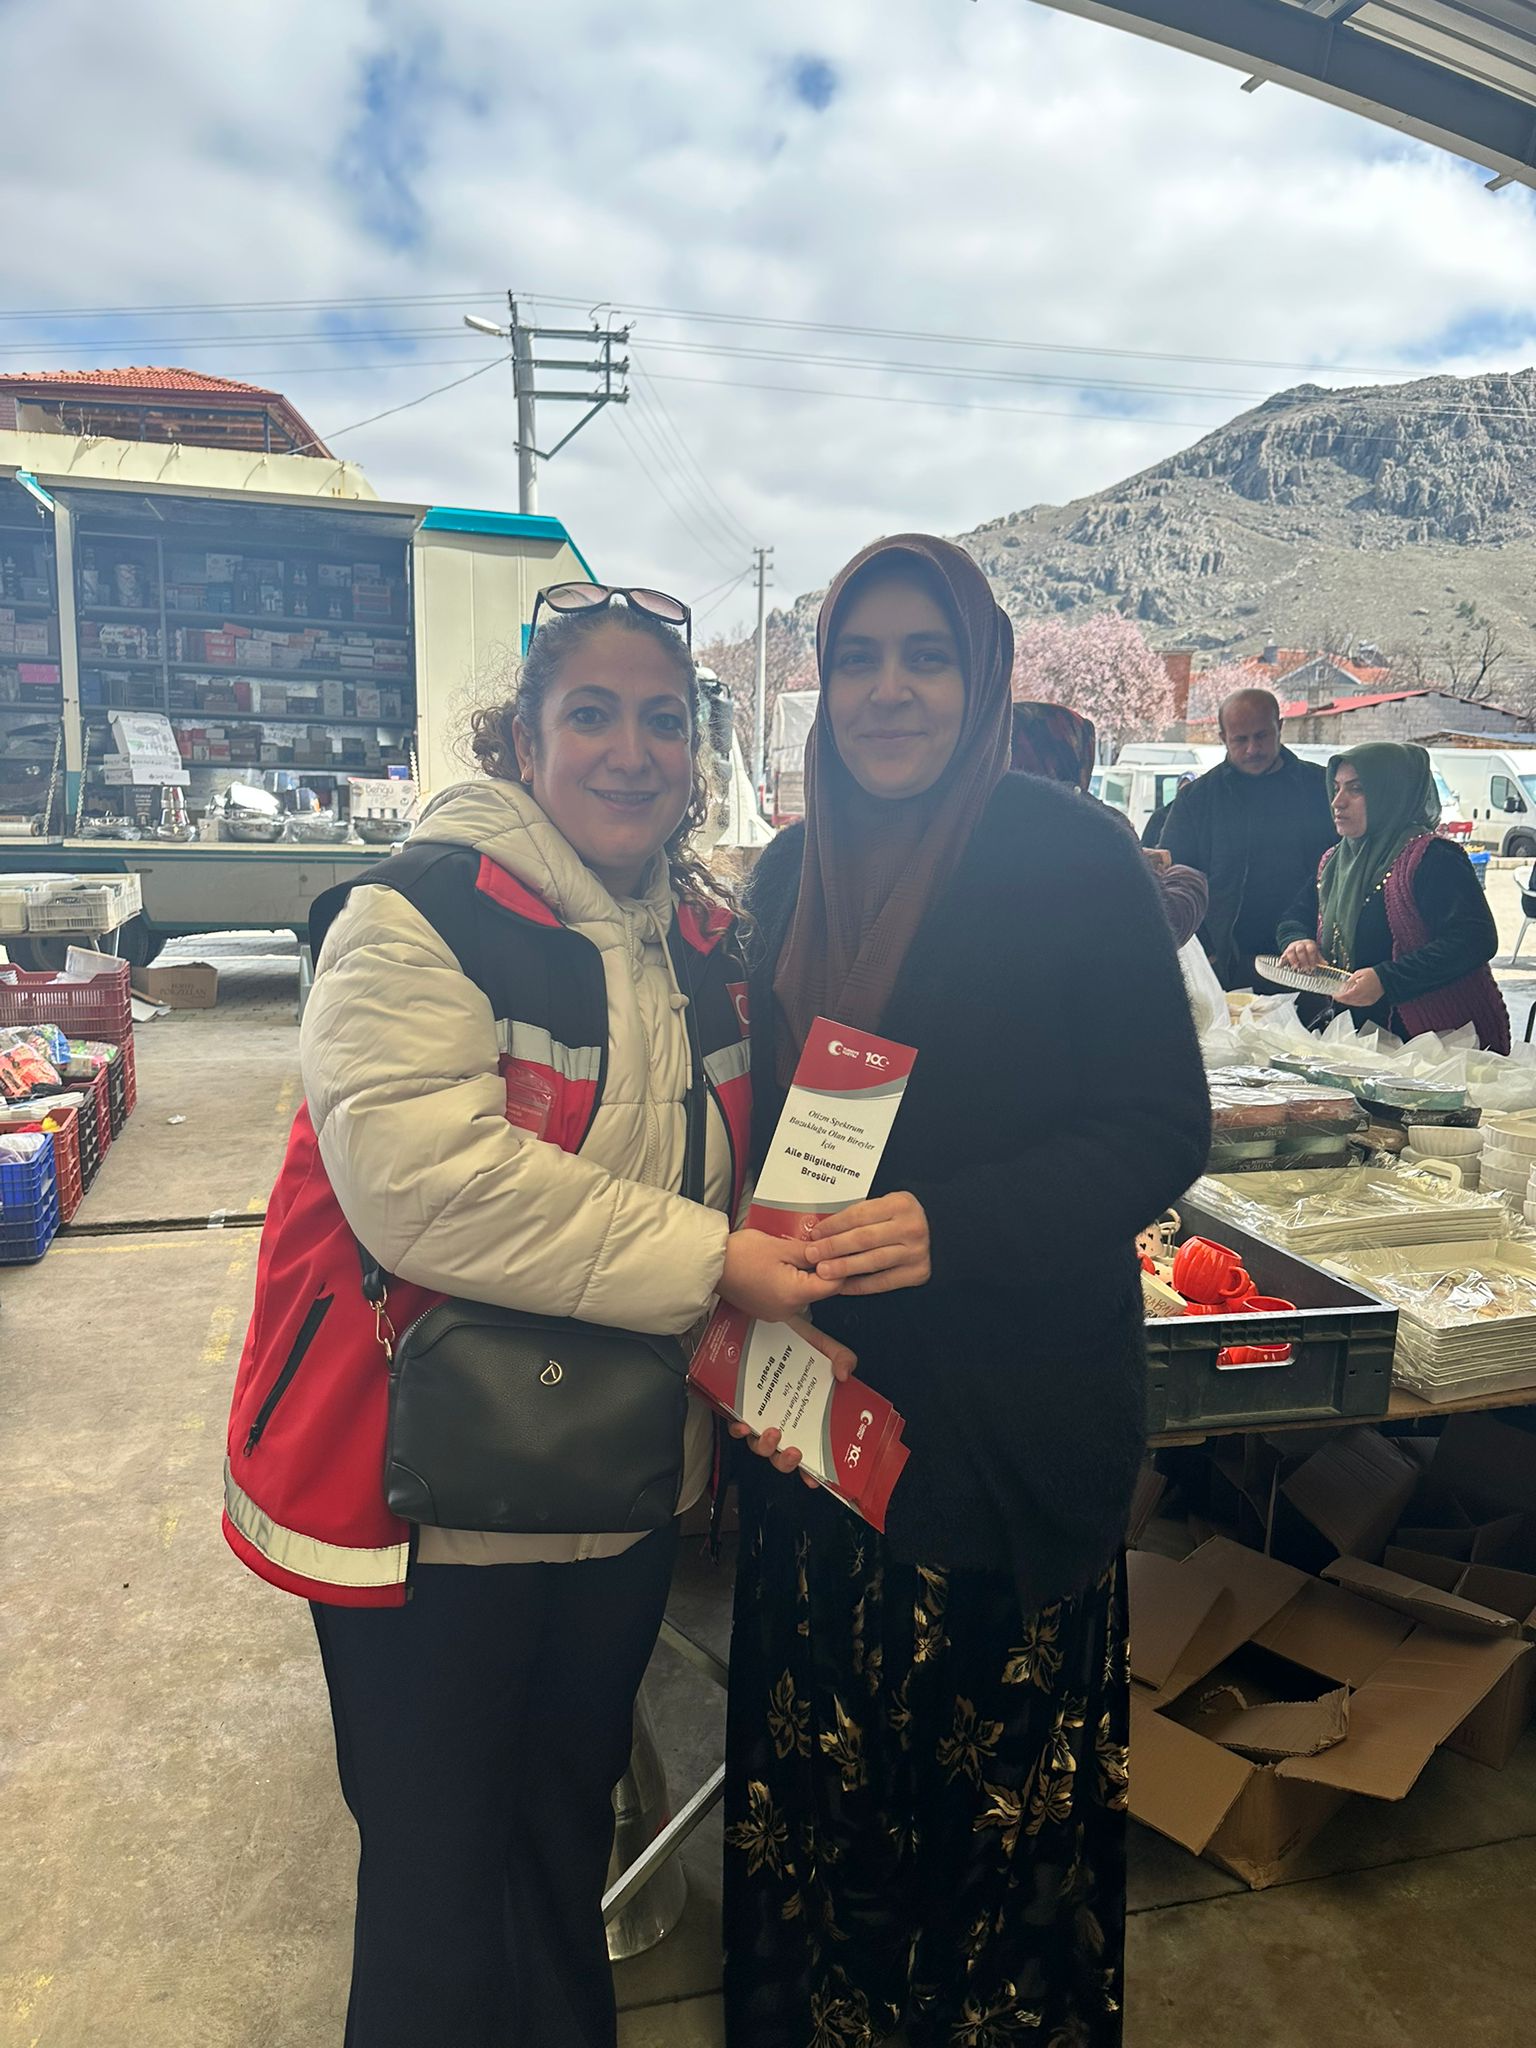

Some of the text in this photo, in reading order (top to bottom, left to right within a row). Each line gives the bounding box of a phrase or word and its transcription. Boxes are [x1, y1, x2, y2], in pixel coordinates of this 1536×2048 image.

[789, 1116, 875, 1150] Bozukluğu Olan Bireyler
[808, 1110, 864, 1134] Otizm Spektrum
[821, 1138, 836, 1151] İçin
[785, 1146, 861, 1178] Aile Bilgilendirme
[801, 1166, 837, 1185] Broşürü
[757, 1356, 776, 1390] Broşürü
[757, 1345, 793, 1416] Aile Bilgilendirme
[789, 1392, 800, 1409] Olan
[792, 1376, 818, 1429] Otizm Spektrum
